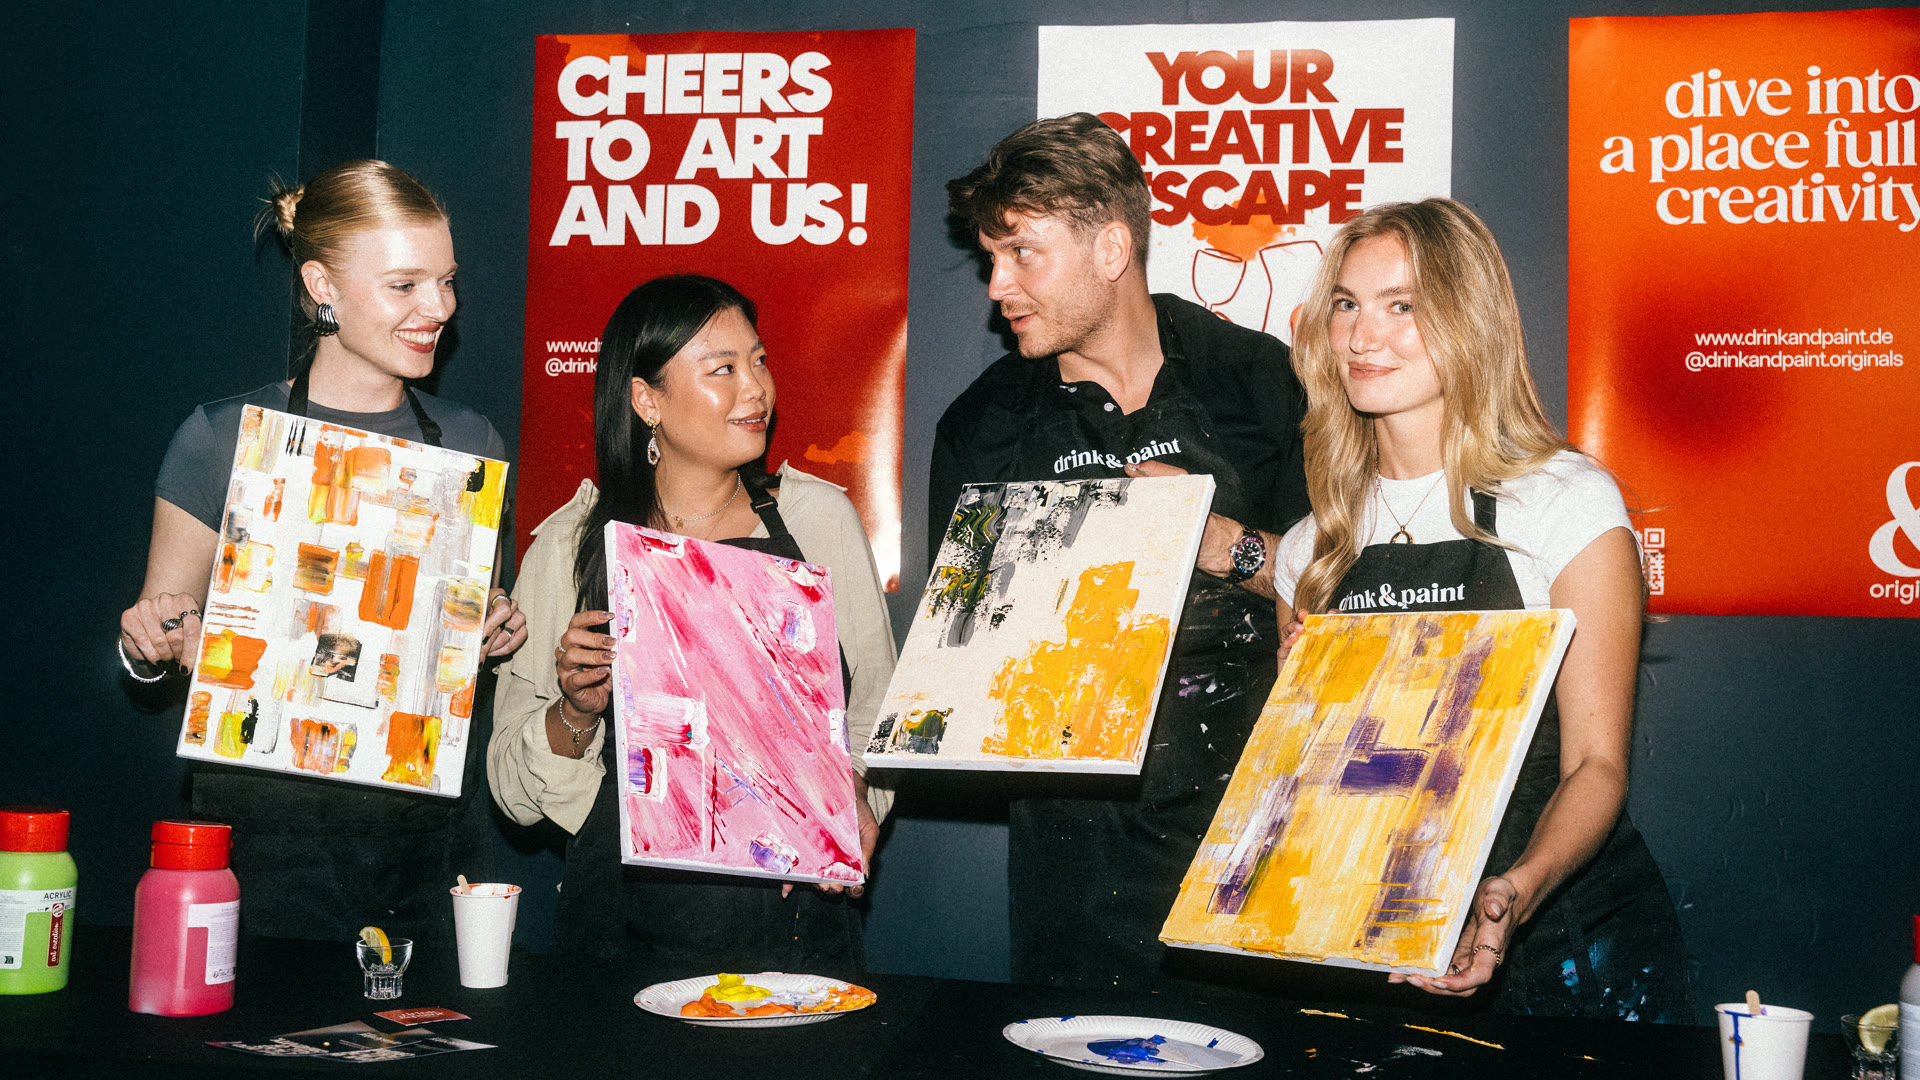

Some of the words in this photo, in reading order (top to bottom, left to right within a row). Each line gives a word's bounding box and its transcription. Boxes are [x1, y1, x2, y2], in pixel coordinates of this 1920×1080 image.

[557, 51, 833, 116] CHEERS
[1145, 48, 1340, 106] YOUR
[1665, 68, 1792, 119] dive
[1807, 65, 1920, 115] into
[555, 119, 651, 181] TO
[674, 117, 824, 180] ART
[1600, 136, 1635, 174] a
[1649, 124, 1810, 183] place
[1824, 118, 1917, 168] full
[548, 184, 721, 246] AND
[750, 182, 868, 246] US!
[1145, 169, 1365, 226] SCAPE
[1656, 171, 1920, 232] creativity
[1685, 350, 1904, 372] @drinkandpaint.originals
[1695, 328, 1894, 349] www.drinkandpaint.de
[44, 890, 72, 899] ACRYLIC
